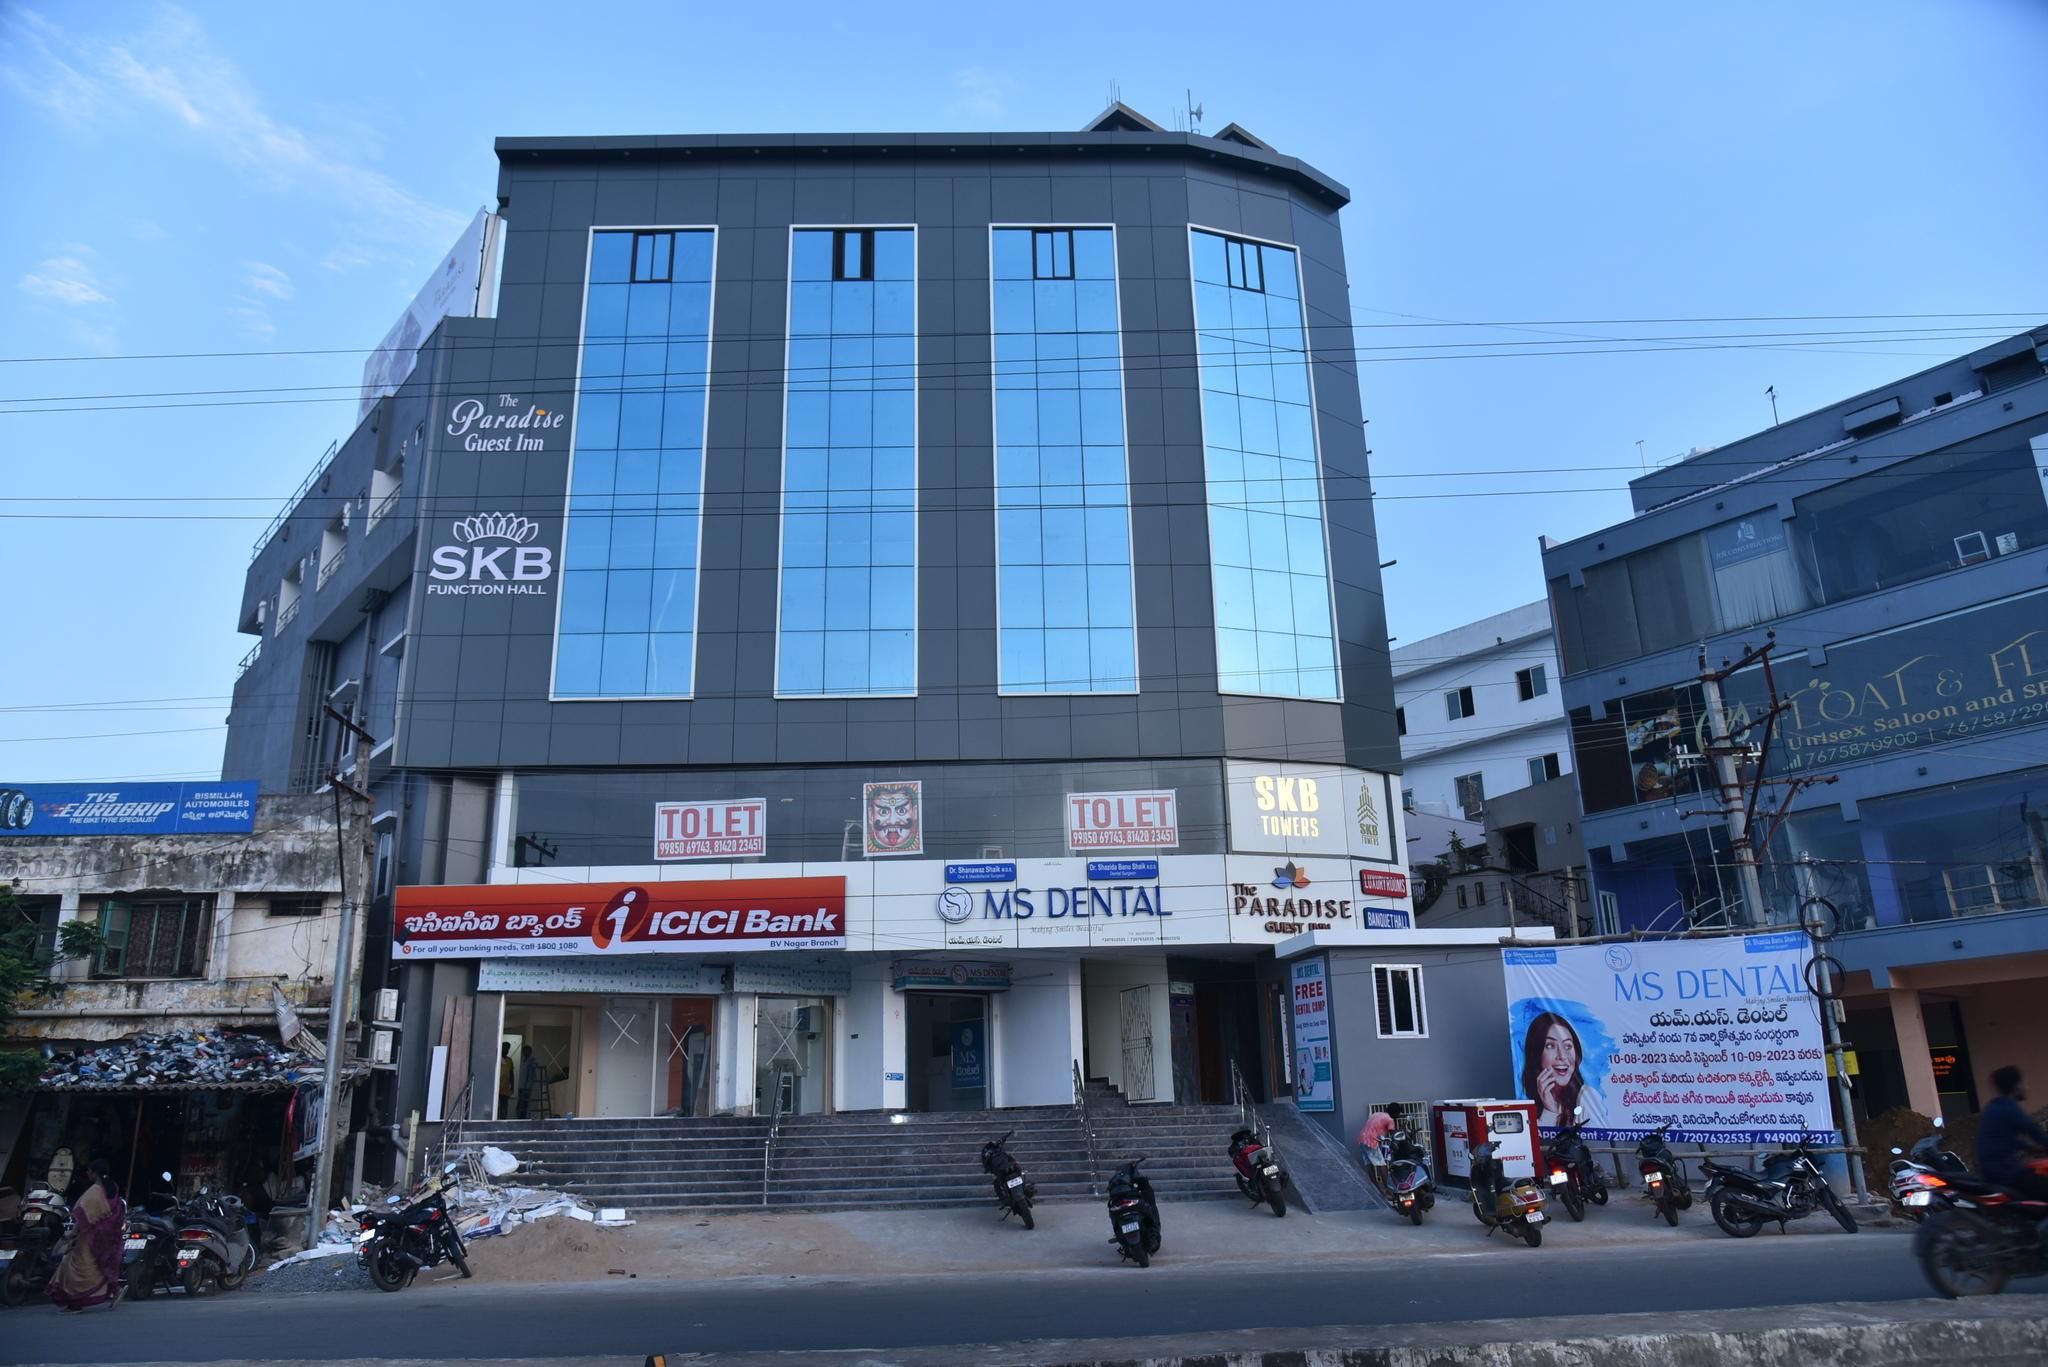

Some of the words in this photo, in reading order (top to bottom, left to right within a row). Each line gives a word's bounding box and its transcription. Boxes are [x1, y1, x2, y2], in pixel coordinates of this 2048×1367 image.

[499, 394, 519, 407] The
[447, 400, 564, 436] Paradise
[465, 433, 512, 451] Guest
[515, 434, 544, 451] Inn
[429, 546, 552, 581] SKB
[427, 584, 504, 595] FUNCTION
[507, 584, 547, 595] HALL
[1936, 669, 1963, 697] &
[1787, 725, 1867, 751] Unisex
[1873, 704, 1958, 733] Saloon
[1965, 688, 2015, 712] and
[1806, 731, 1918, 766] 7675870900
[1946, 700, 2048, 736] 76758729
[86, 793, 120, 802] TVS
[195, 792, 243, 800] BISMILLAH
[1255, 776, 1319, 812] SKB
[57, 802, 176, 817] EUROGRIP
[184, 800, 250, 808] AUTOMOBILES
[1261, 815, 1319, 837] TOWERS
[1360, 823, 1378, 836] SKB
[1073, 831, 1097, 844] 99850
[1100, 831, 1125, 844] 69743,
[1127, 830, 1149, 842] 81420
[1151, 829, 1174, 841] 23451
[660, 841, 684, 855] 99850
[686, 841, 712, 855] 69743,
[714, 839, 737, 853] 81420
[739, 838, 761, 851] 23451
[1132, 862, 1145, 870] Shaik
[1232, 883, 1257, 896] The
[984, 888, 1034, 919] MS
[1047, 885, 1173, 919] DENTAL
[1234, 897, 1352, 919] PARADISE
[404, 910, 500, 933] ఐసిఐసిఐ
[506, 906, 586, 937] బ్యాంక్
[648, 910, 740, 935] ICICI
[743, 908, 838, 933] Bank
[1265, 921, 1304, 933] GUEST
[1368, 911, 1393, 928] BANQUET
[1394, 914, 1408, 929] HALL
[413, 945, 426, 953] For
[427, 944, 438, 953] all
[440, 946, 457, 955] your
[459, 943, 491, 954] banking
[494, 943, 519, 951] needs,
[520, 943, 535, 951] call
[537, 942, 556, 950] 1800
[559, 941, 578, 950] 1080
[770, 940, 782, 948] BV
[783, 939, 809, 949] Nagar
[811, 938, 839, 946] Branch
[970, 968, 982, 976] MS
[1295, 981, 1323, 1000] FREE
[1614, 971, 1663, 1002] MS
[1677, 963, 1809, 999] DENTAL
[1296, 1003, 1311, 1015] DENTAL
[1312, 1000, 1325, 1012] CAMP
[1650, 1008, 1733, 1027] యమ్.యస్.
[1737, 1004, 1788, 1024] డెంటల్
[1658, 1032, 1681, 1043] నందు
[1684, 1032, 1697, 1043] 7వ
[1608, 1053, 1667, 1064] 10-08-2023
[1669, 1050, 1692, 1064] నుండి
[1693, 1049, 1728, 1067] సెప్టెంబర్
[1731, 1050, 1796, 1062] 10-09-2023
[1798, 1049, 1823, 1060] వరకు
[1611, 1073, 1633, 1084] ఉచిత
[1634, 1073, 1660, 1087] క్యాంప్
[1661, 1073, 1695, 1084] మరియు
[1697, 1072, 1737, 1083] ఉచితంగా
[1775, 1071, 1823, 1086] ఇవ్వబడును
[1662, 1091, 1680, 1103] మీద
[1682, 1091, 1704, 1103] తగిన
[1737, 1091, 1784, 1107] ఇవ్వబడును
[1785, 1093, 1814, 1105] కావున
[1538, 1130, 1598, 1140] Appent
[1607, 1131, 1671, 1141] 7207935
[1683, 1132, 1751, 1143] 7207632535
[1764, 1132, 1837, 1144] 94900212
